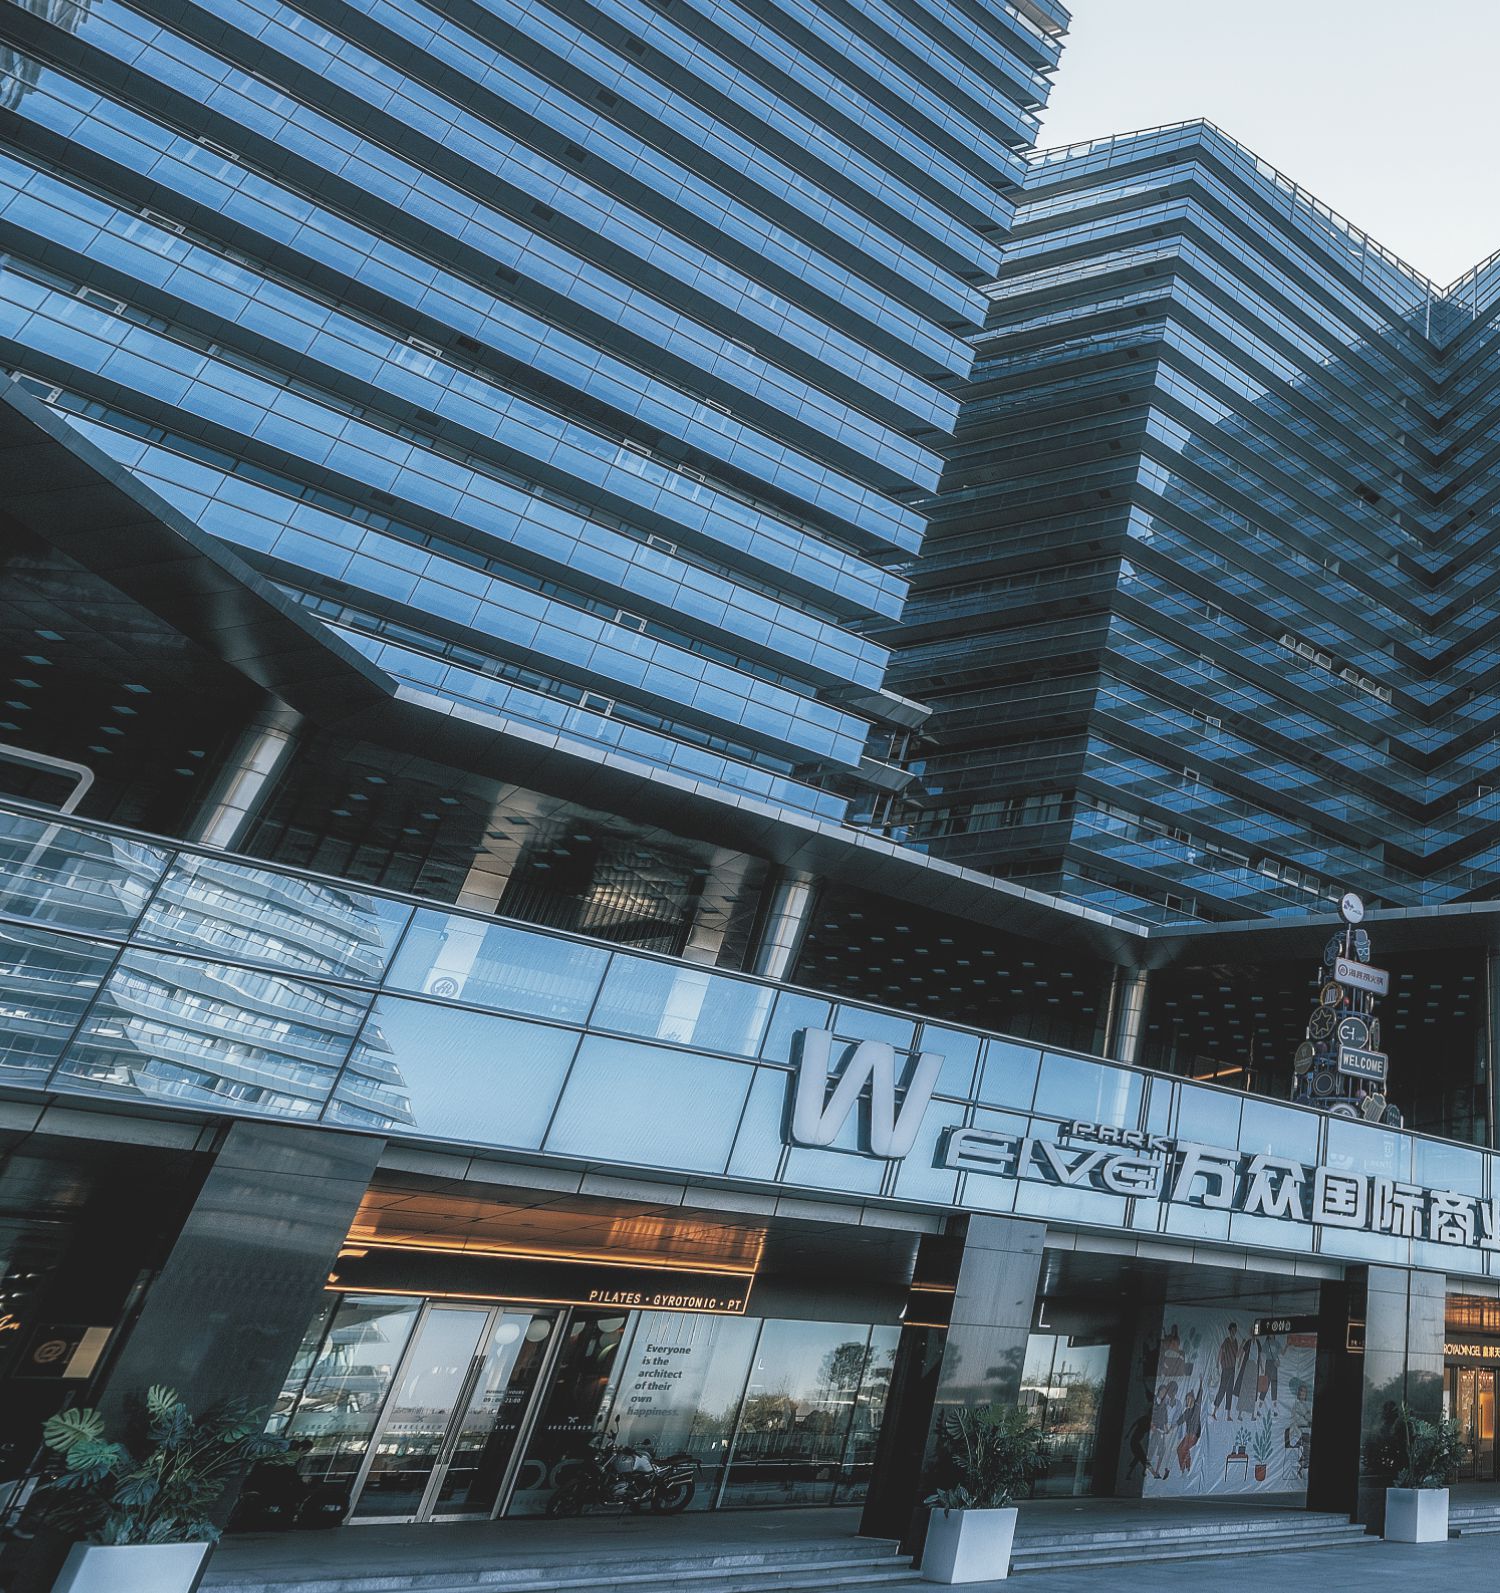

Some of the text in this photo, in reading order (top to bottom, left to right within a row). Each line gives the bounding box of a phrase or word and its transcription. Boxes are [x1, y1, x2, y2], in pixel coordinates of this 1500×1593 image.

[1343, 1052, 1383, 1073] WELCOME
[1071, 1119, 1172, 1153] PARK
[589, 1290, 742, 1310] PILATES GYROTONIC PT
[646, 1344, 692, 1355] Everyone
[642, 1356, 669, 1366] is the
[638, 1369, 683, 1379] architect
[635, 1382, 672, 1391] of their
[627, 1407, 679, 1418] happiness.
